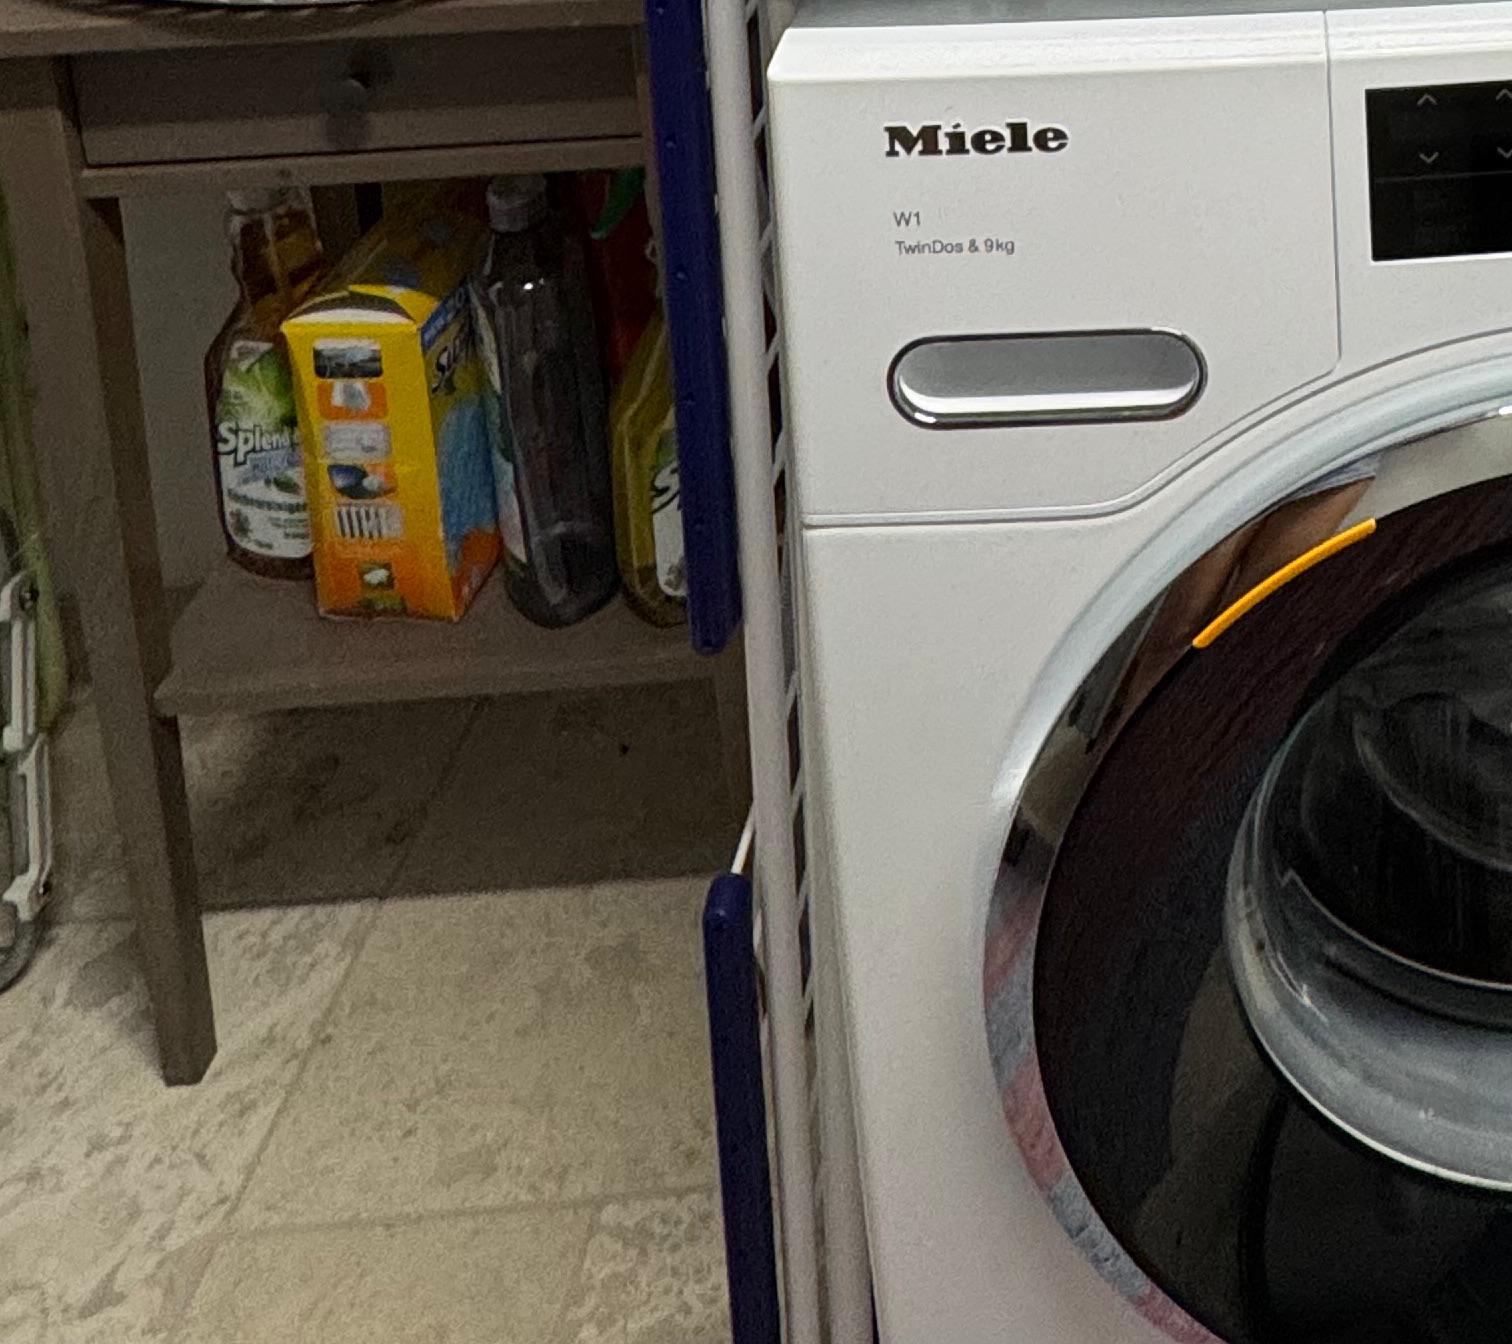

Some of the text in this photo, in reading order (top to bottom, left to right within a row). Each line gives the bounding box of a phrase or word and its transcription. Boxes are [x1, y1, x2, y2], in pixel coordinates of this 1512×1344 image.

[884, 122, 1069, 158] Miele
[893, 210, 921, 228] W1
[895, 238, 964, 255] TwinDos
[967, 238, 979, 253] &
